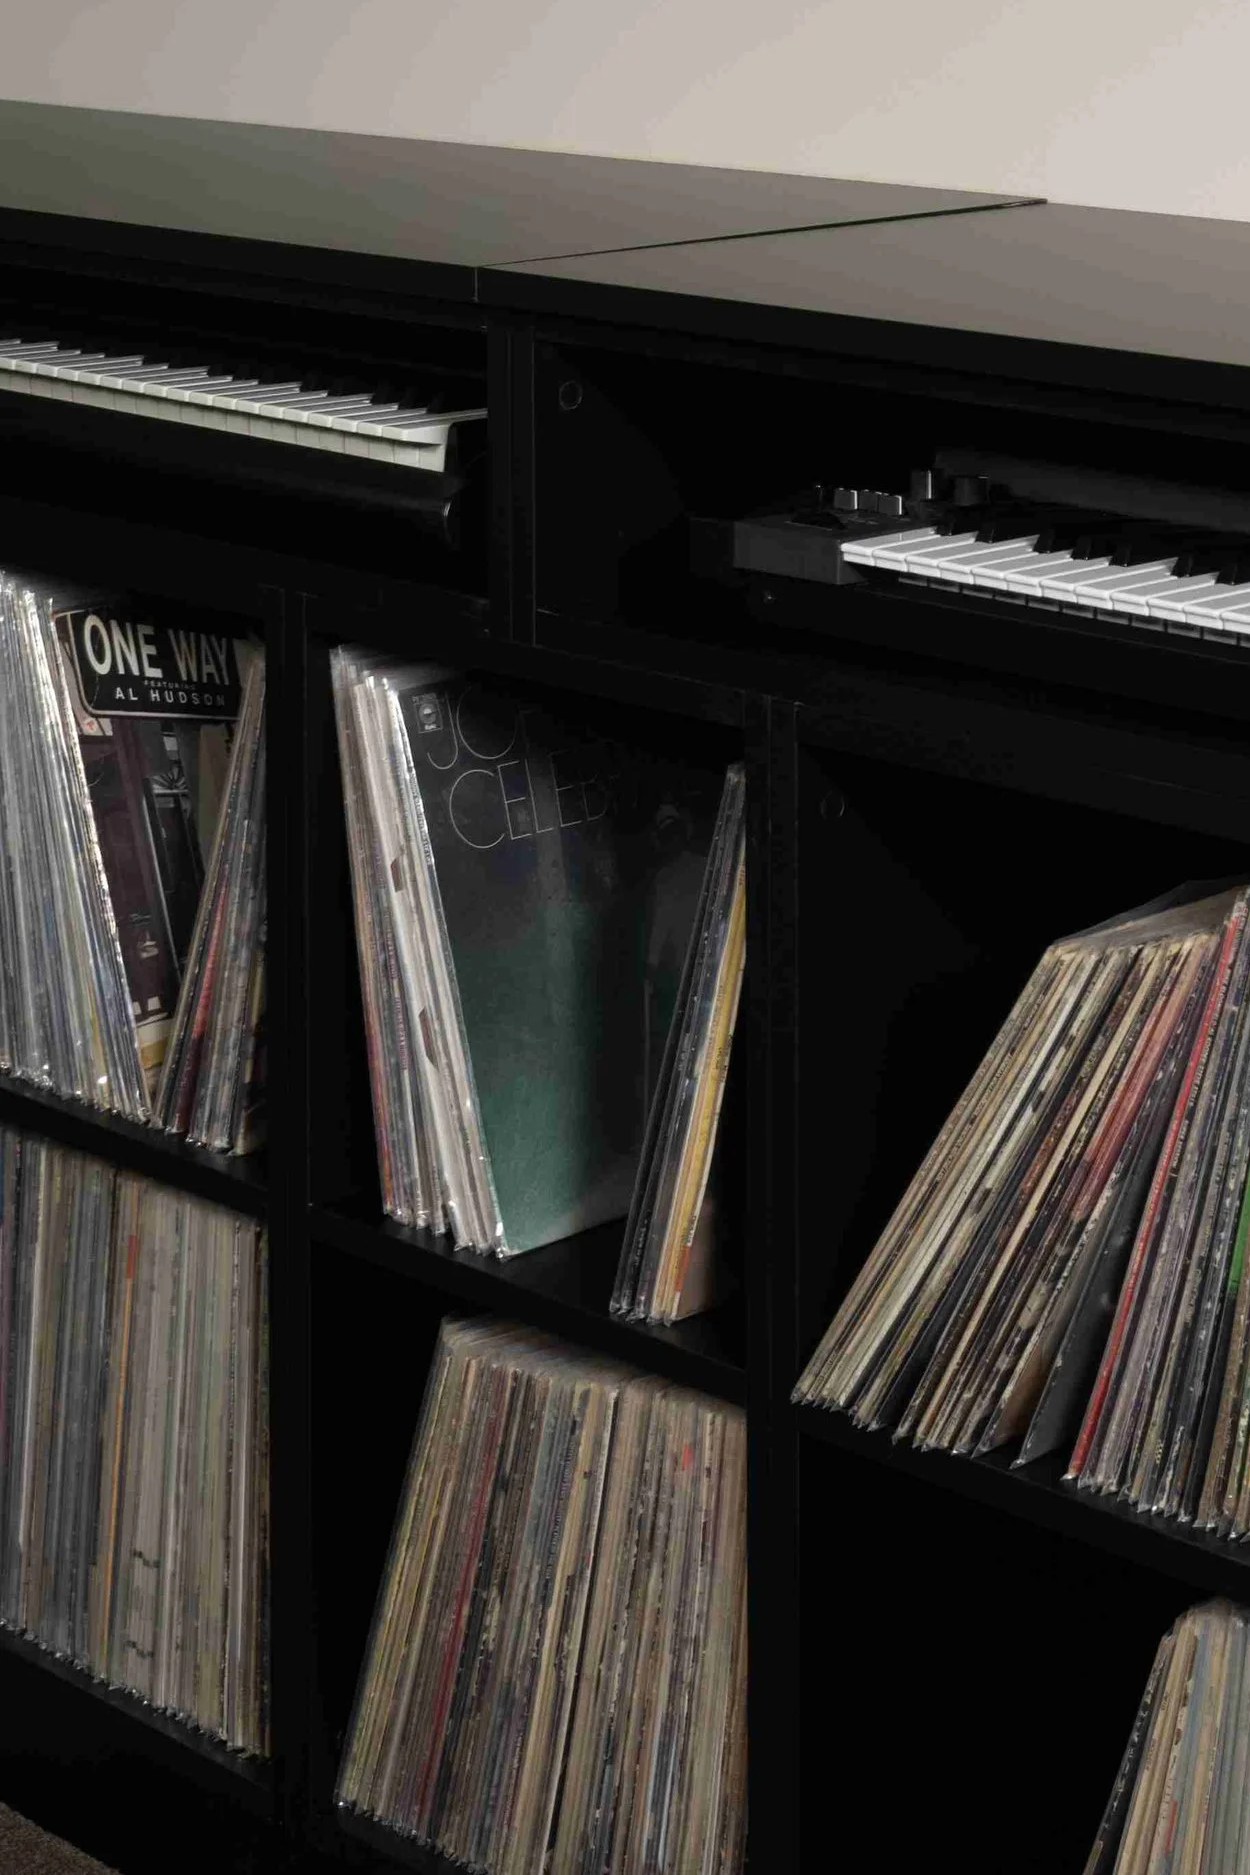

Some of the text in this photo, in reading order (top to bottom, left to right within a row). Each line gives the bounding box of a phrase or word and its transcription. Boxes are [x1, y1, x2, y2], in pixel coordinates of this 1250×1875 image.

[83, 613, 230, 686] ONE WAY
[115, 686, 226, 707] AL HUDSON
